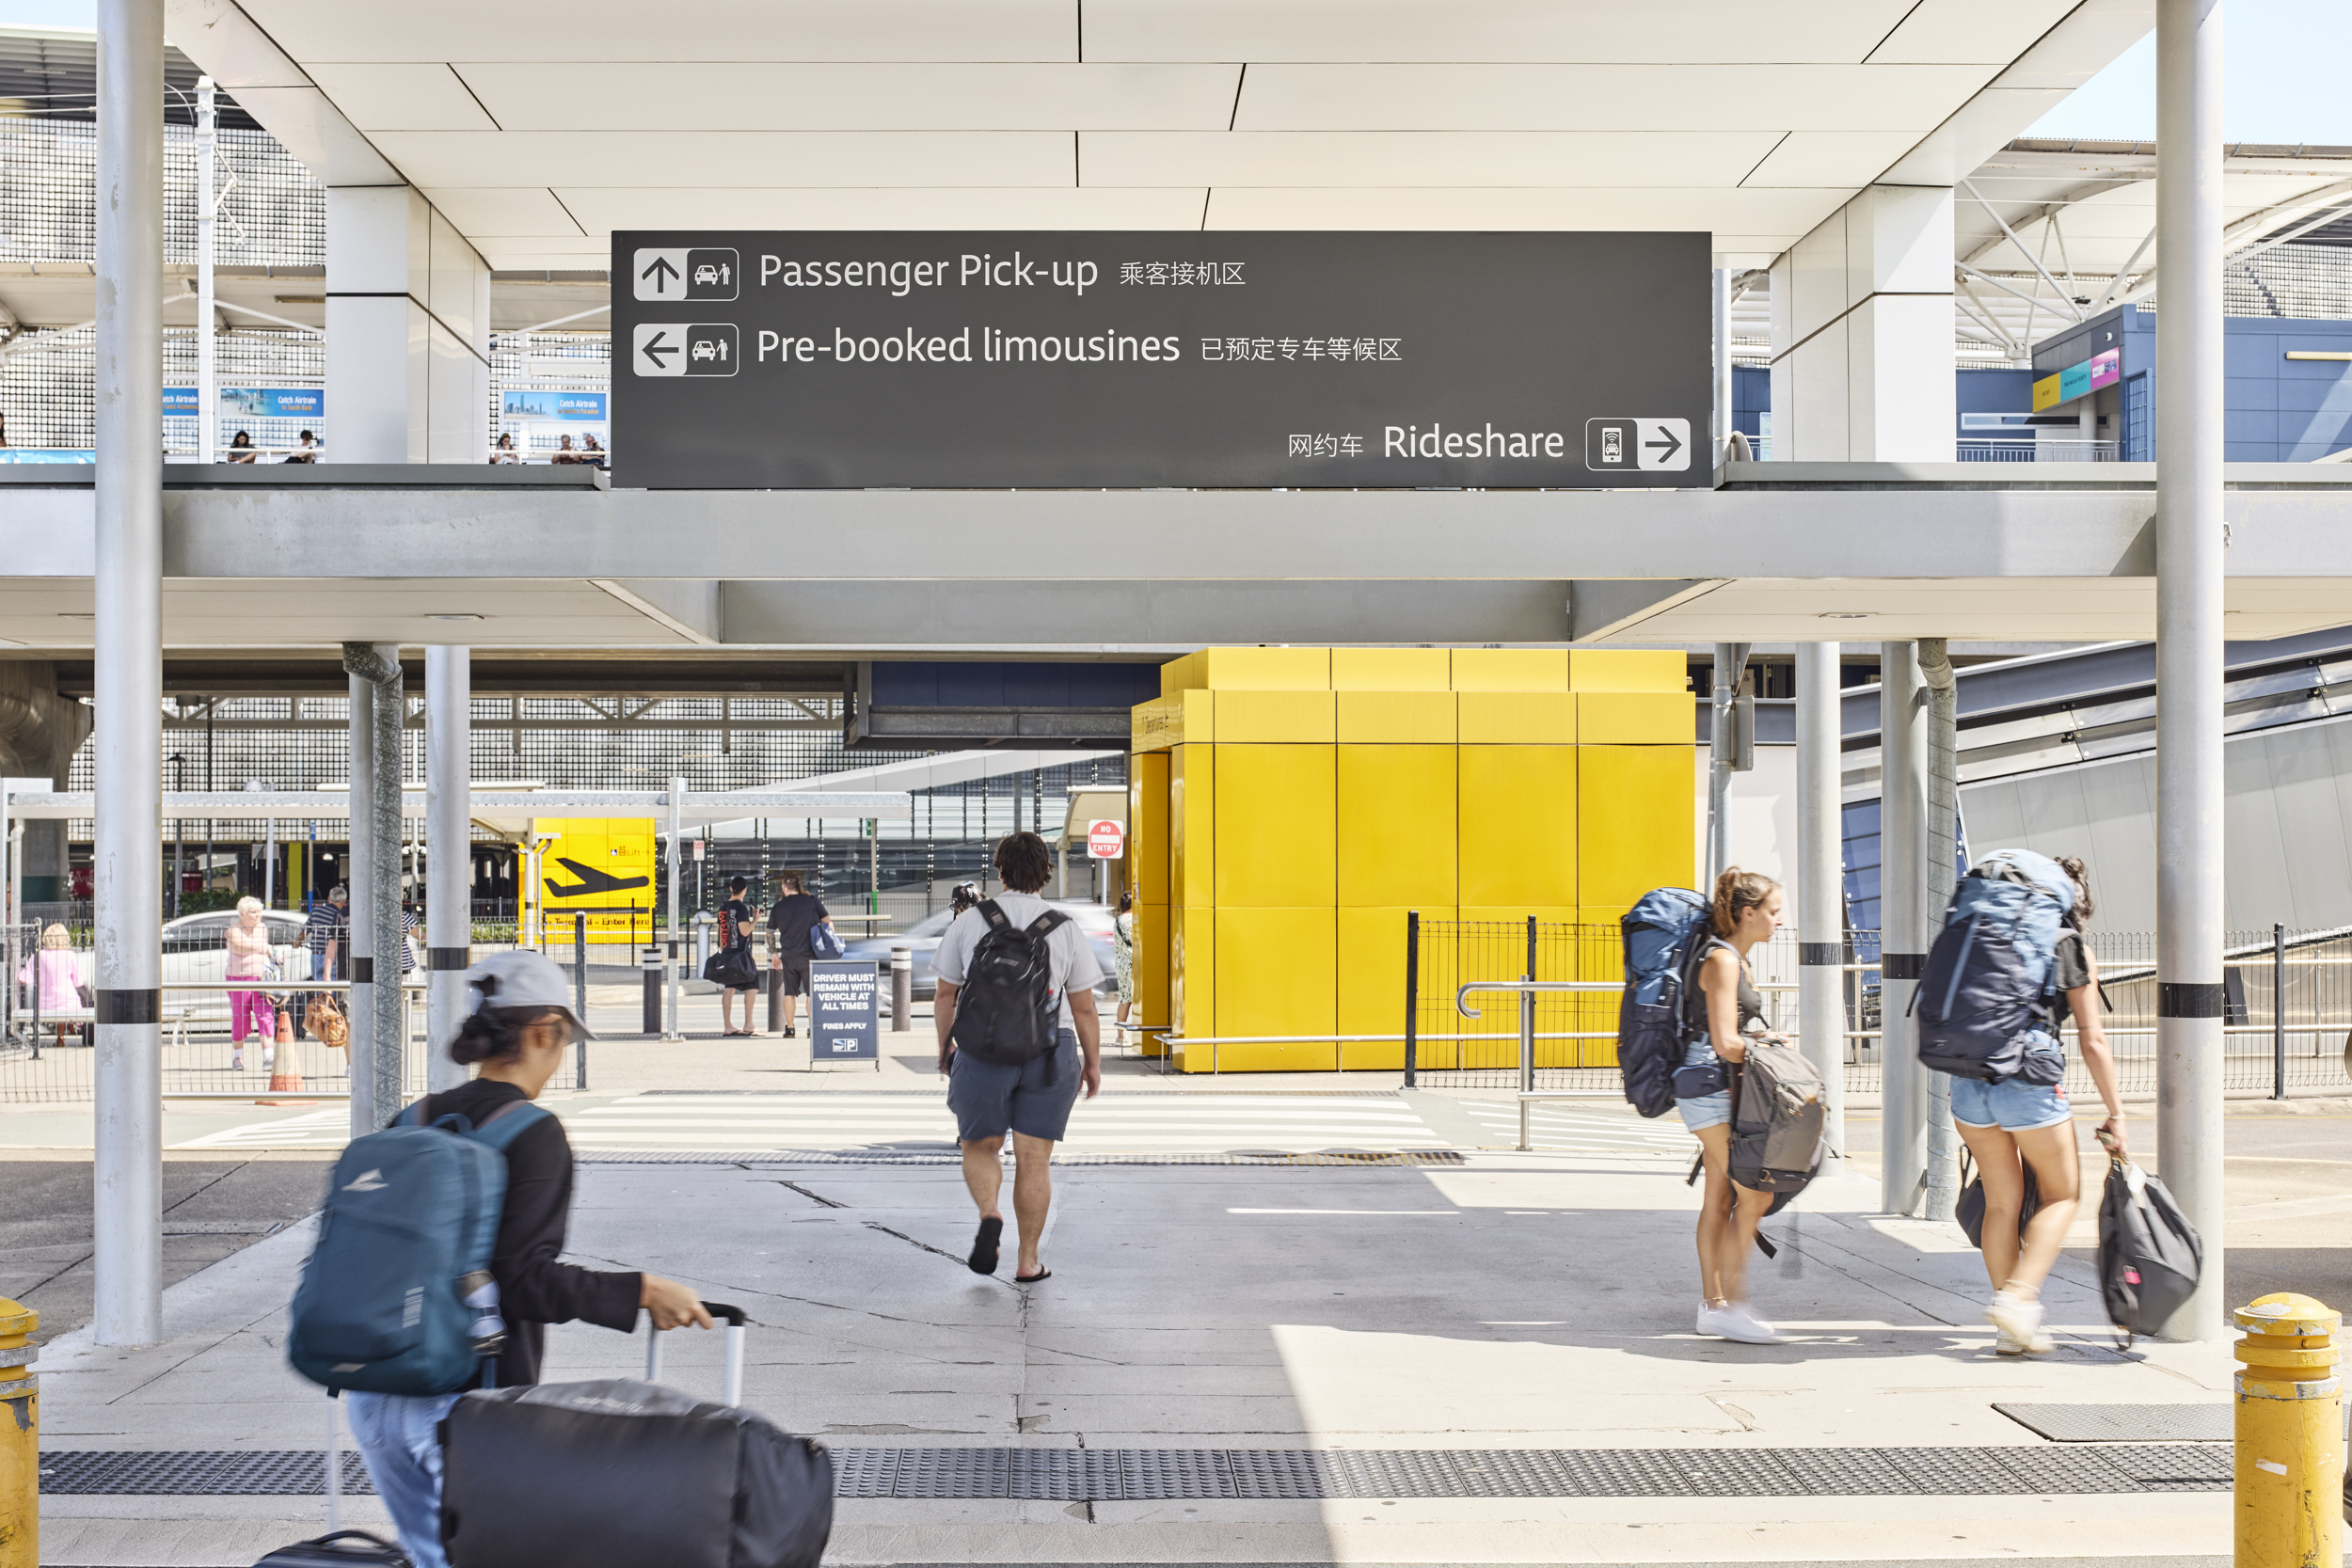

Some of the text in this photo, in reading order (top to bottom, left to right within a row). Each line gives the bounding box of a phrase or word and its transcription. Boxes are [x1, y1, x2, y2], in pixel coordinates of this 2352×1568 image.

[760, 251, 1098, 297] Passenger Pick-up
[1120, 261, 1246, 286] 乘客接机区
[758, 326, 1181, 362] Pre-booked limousines
[1200, 336, 1403, 361] 已预定专车等候区
[176, 395, 198, 404] Airtrain
[1289, 433, 1364, 458] 网约车
[1385, 422, 1565, 458] Rideshare
[1092, 825, 1117, 852] NO ENTRY
[848, 974, 875, 982] MUST
[850, 983, 874, 991] WITH
[847, 1040, 855, 1050] P
